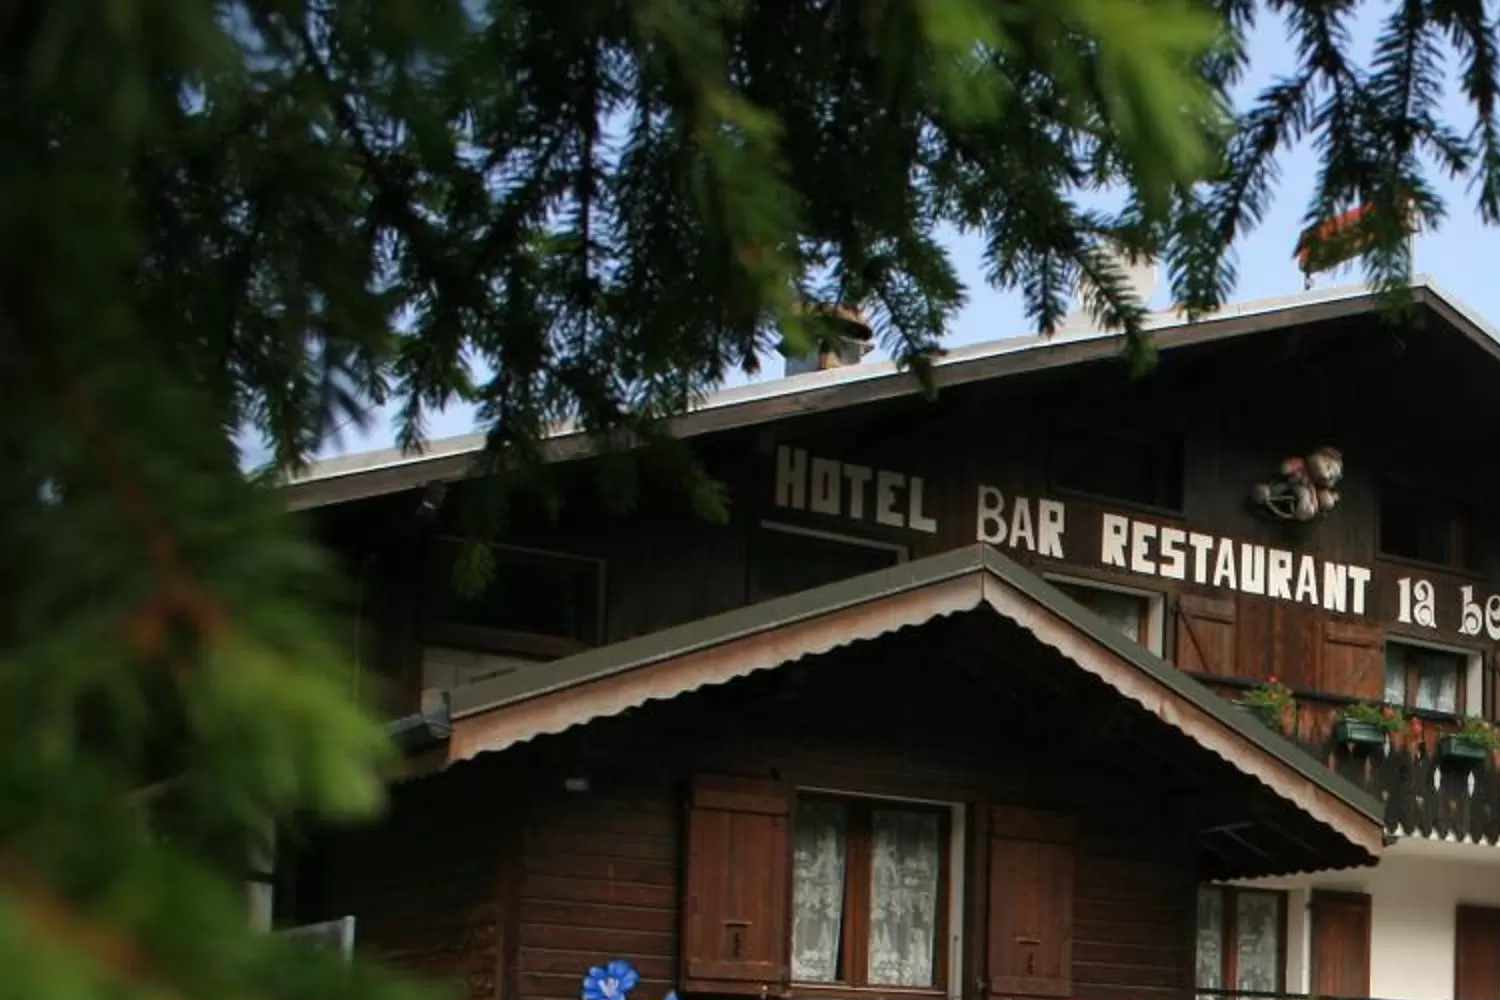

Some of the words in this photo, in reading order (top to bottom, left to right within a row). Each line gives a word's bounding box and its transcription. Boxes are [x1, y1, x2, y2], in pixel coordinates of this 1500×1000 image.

[775, 445, 937, 533] HOTEL
[977, 484, 1065, 559] BAR
[1101, 513, 1371, 615] RESTAURANT
